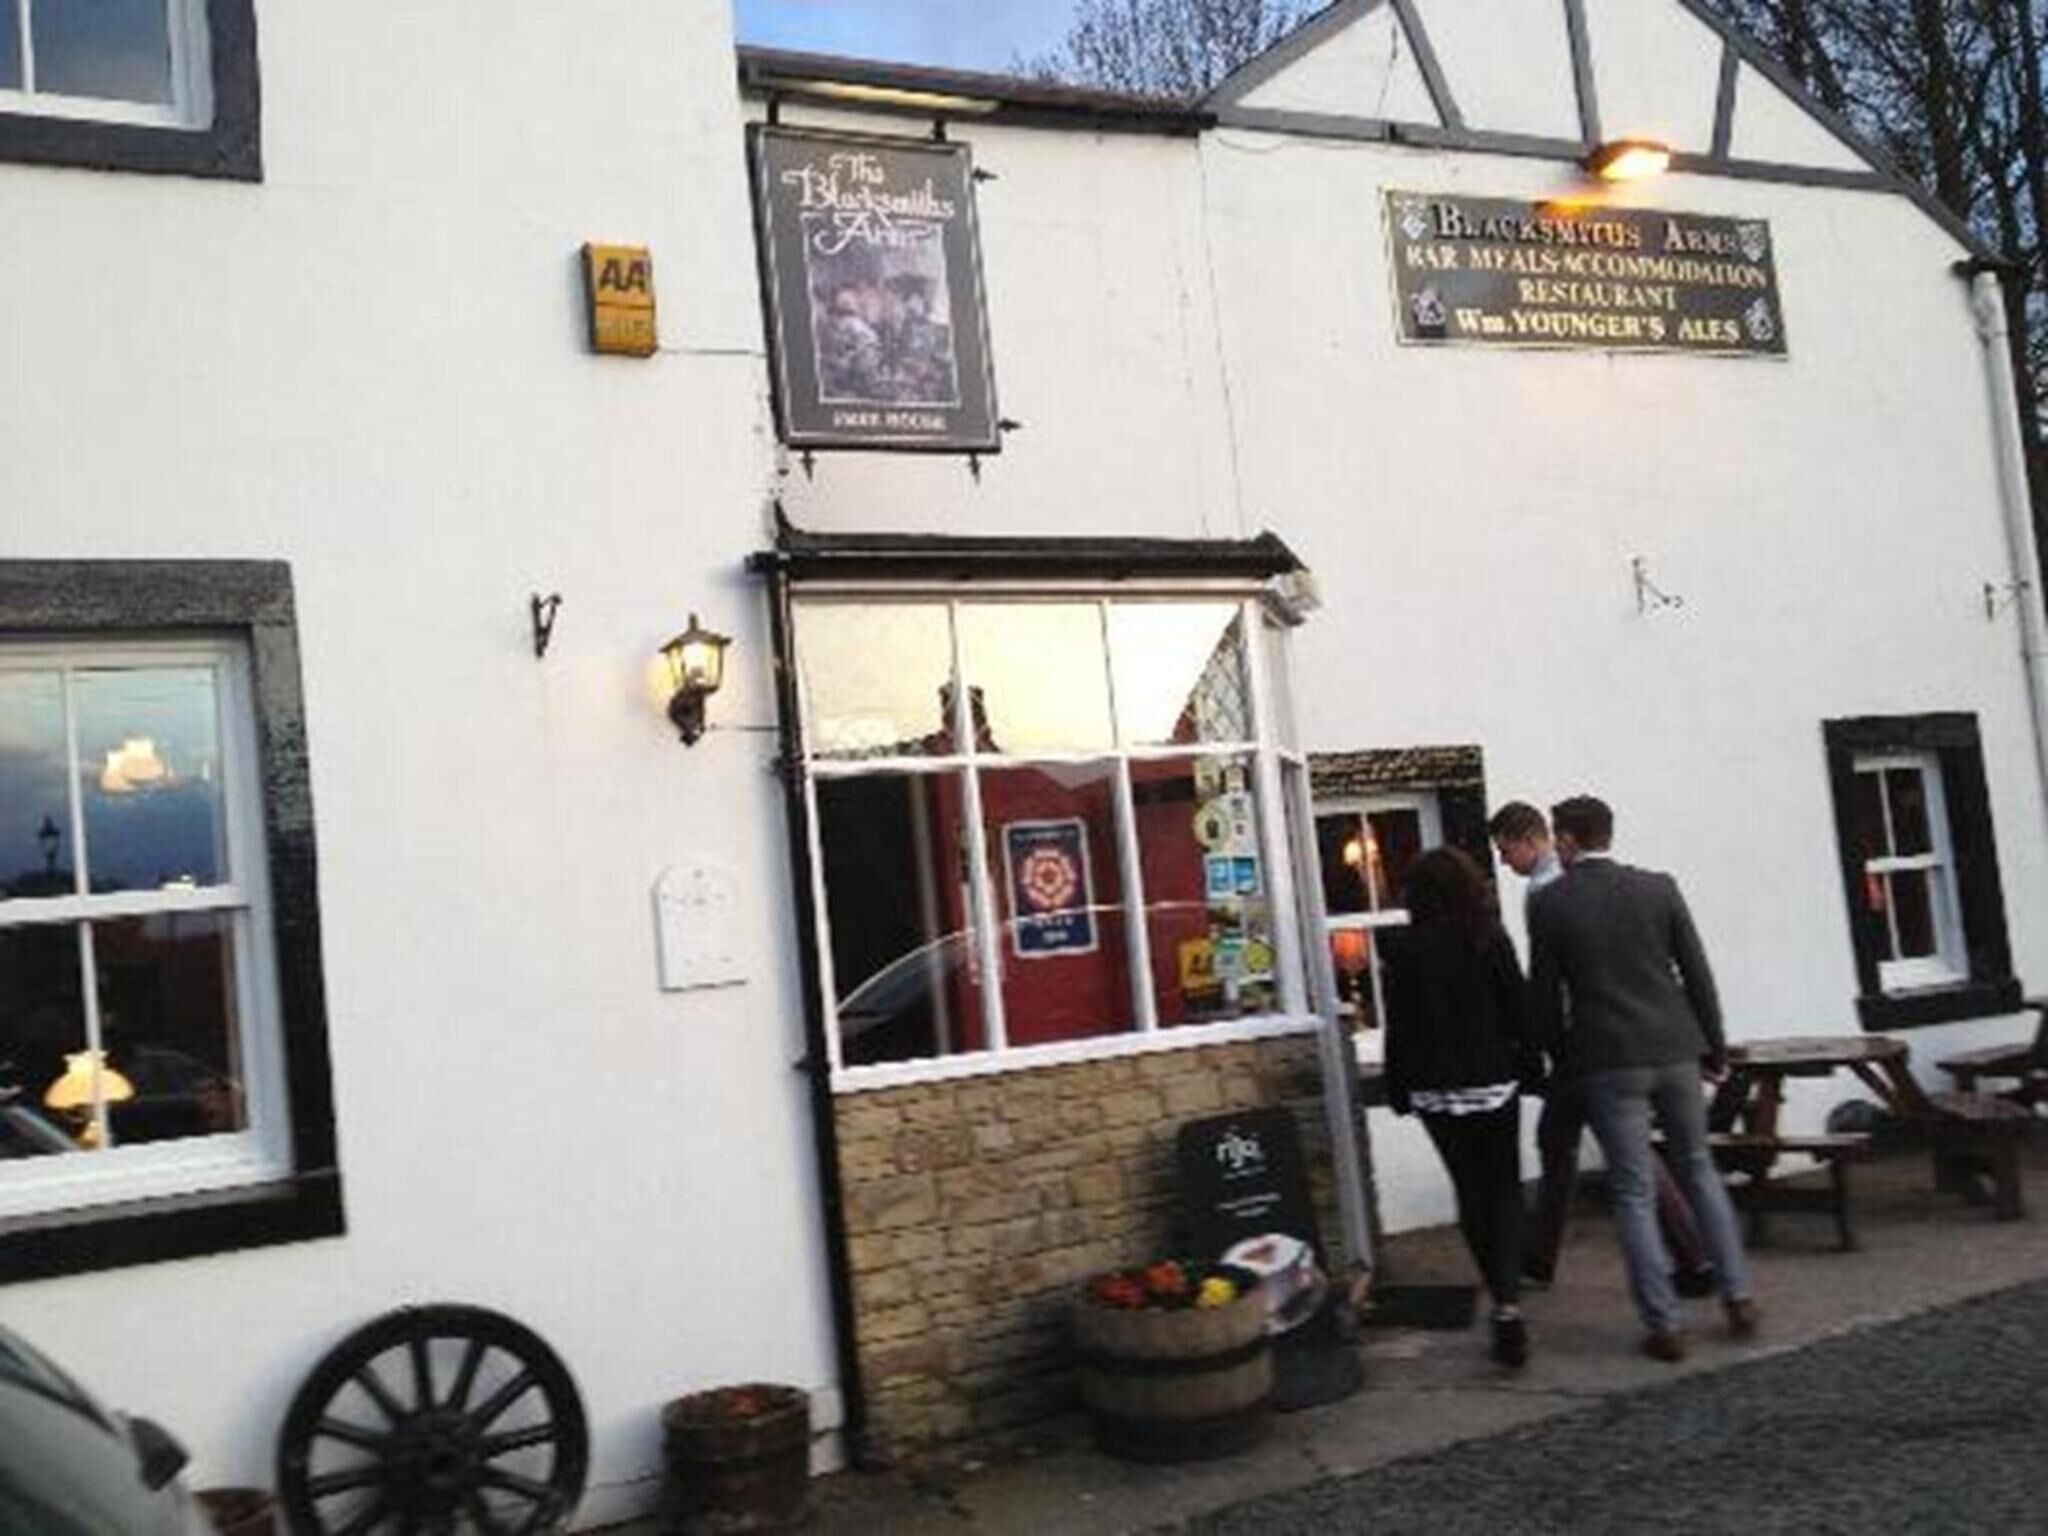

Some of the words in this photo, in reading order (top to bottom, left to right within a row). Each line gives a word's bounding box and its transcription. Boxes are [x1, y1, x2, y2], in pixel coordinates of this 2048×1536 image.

[828, 151, 885, 185] The
[599, 257, 650, 293] AA
[1518, 278, 1676, 310] RESTAURANT
[1678, 319, 1740, 342] ALES
